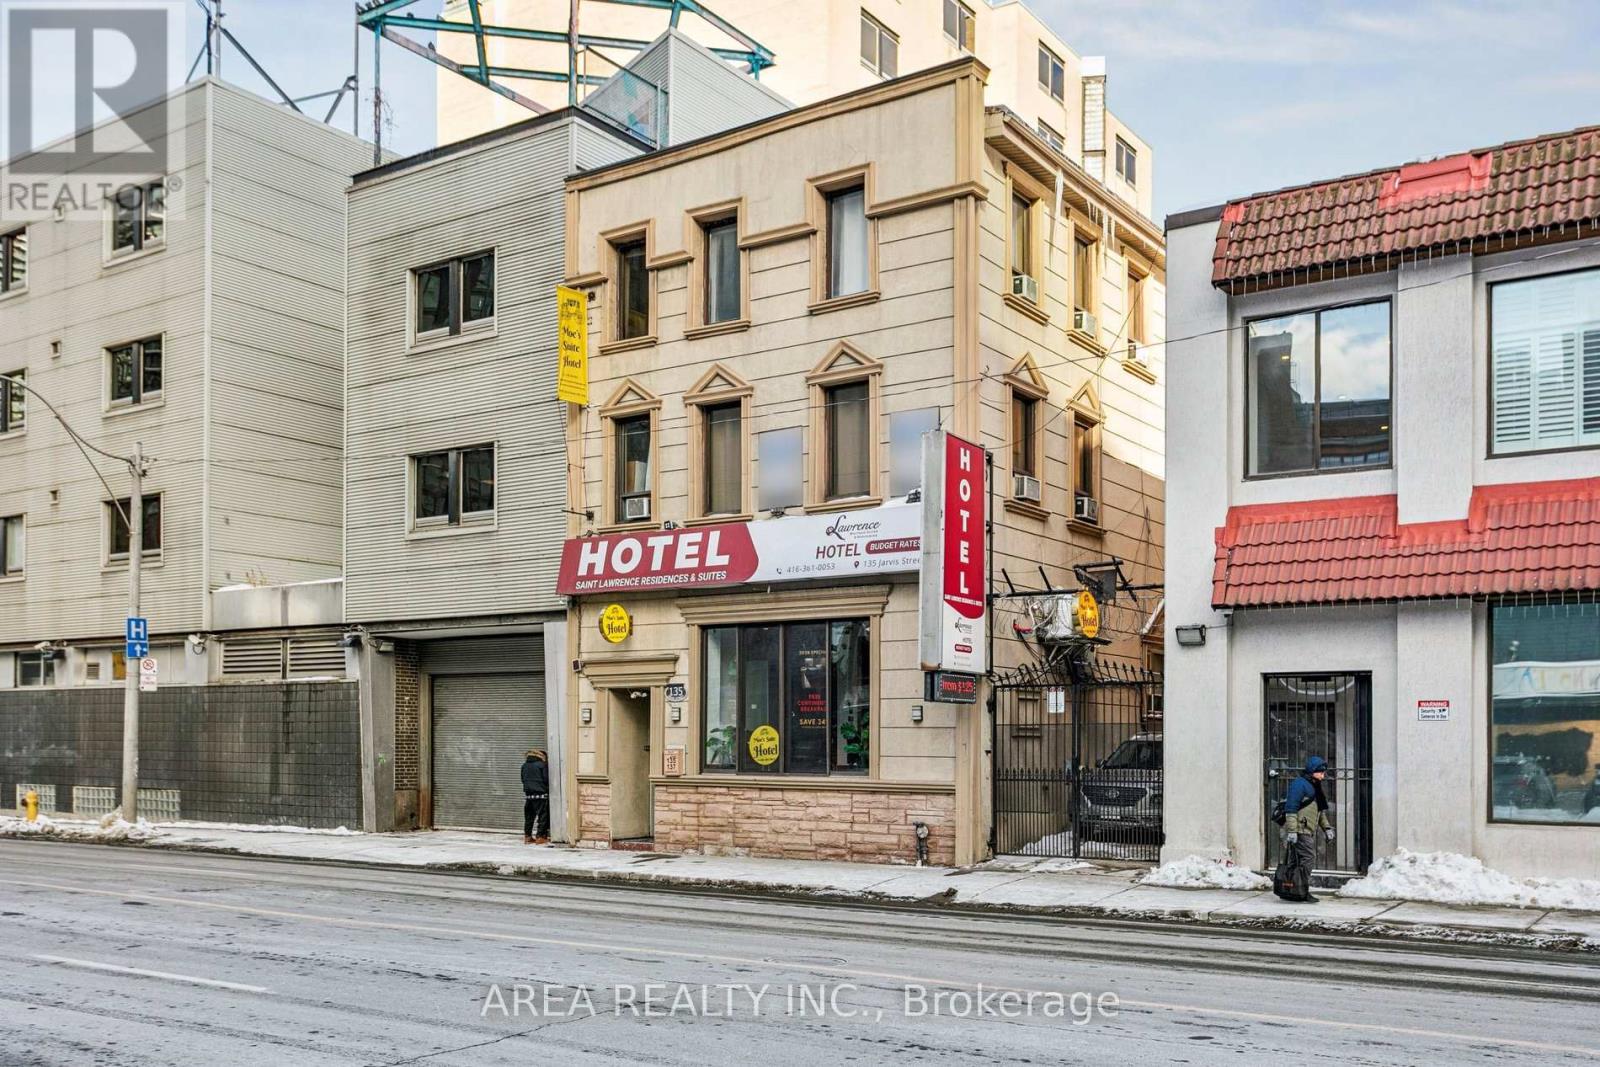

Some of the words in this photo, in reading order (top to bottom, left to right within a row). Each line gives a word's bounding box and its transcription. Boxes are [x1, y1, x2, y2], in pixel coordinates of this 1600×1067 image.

[563, 356, 582, 369] Hotel
[826, 514, 881, 540] Lawrence
[959, 447, 971, 595] HOTEL
[577, 531, 730, 576] HOTEL
[815, 543, 862, 559] HOTEL
[869, 541, 898, 551] BUDGET
[864, 559, 877, 567] 135
[878, 558, 900, 568] Jarvis
[575, 580, 598, 590] SAINT
[599, 577, 640, 588] LAWRENCE
[640, 573, 689, 586] RESIDENCES
[690, 573, 696, 582] &
[697, 570, 727, 581] SUITES
[131, 621, 144, 639] H
[607, 621, 627, 636] Hotel
[669, 687, 683, 696] 135
[753, 743, 778, 759] Hotel
